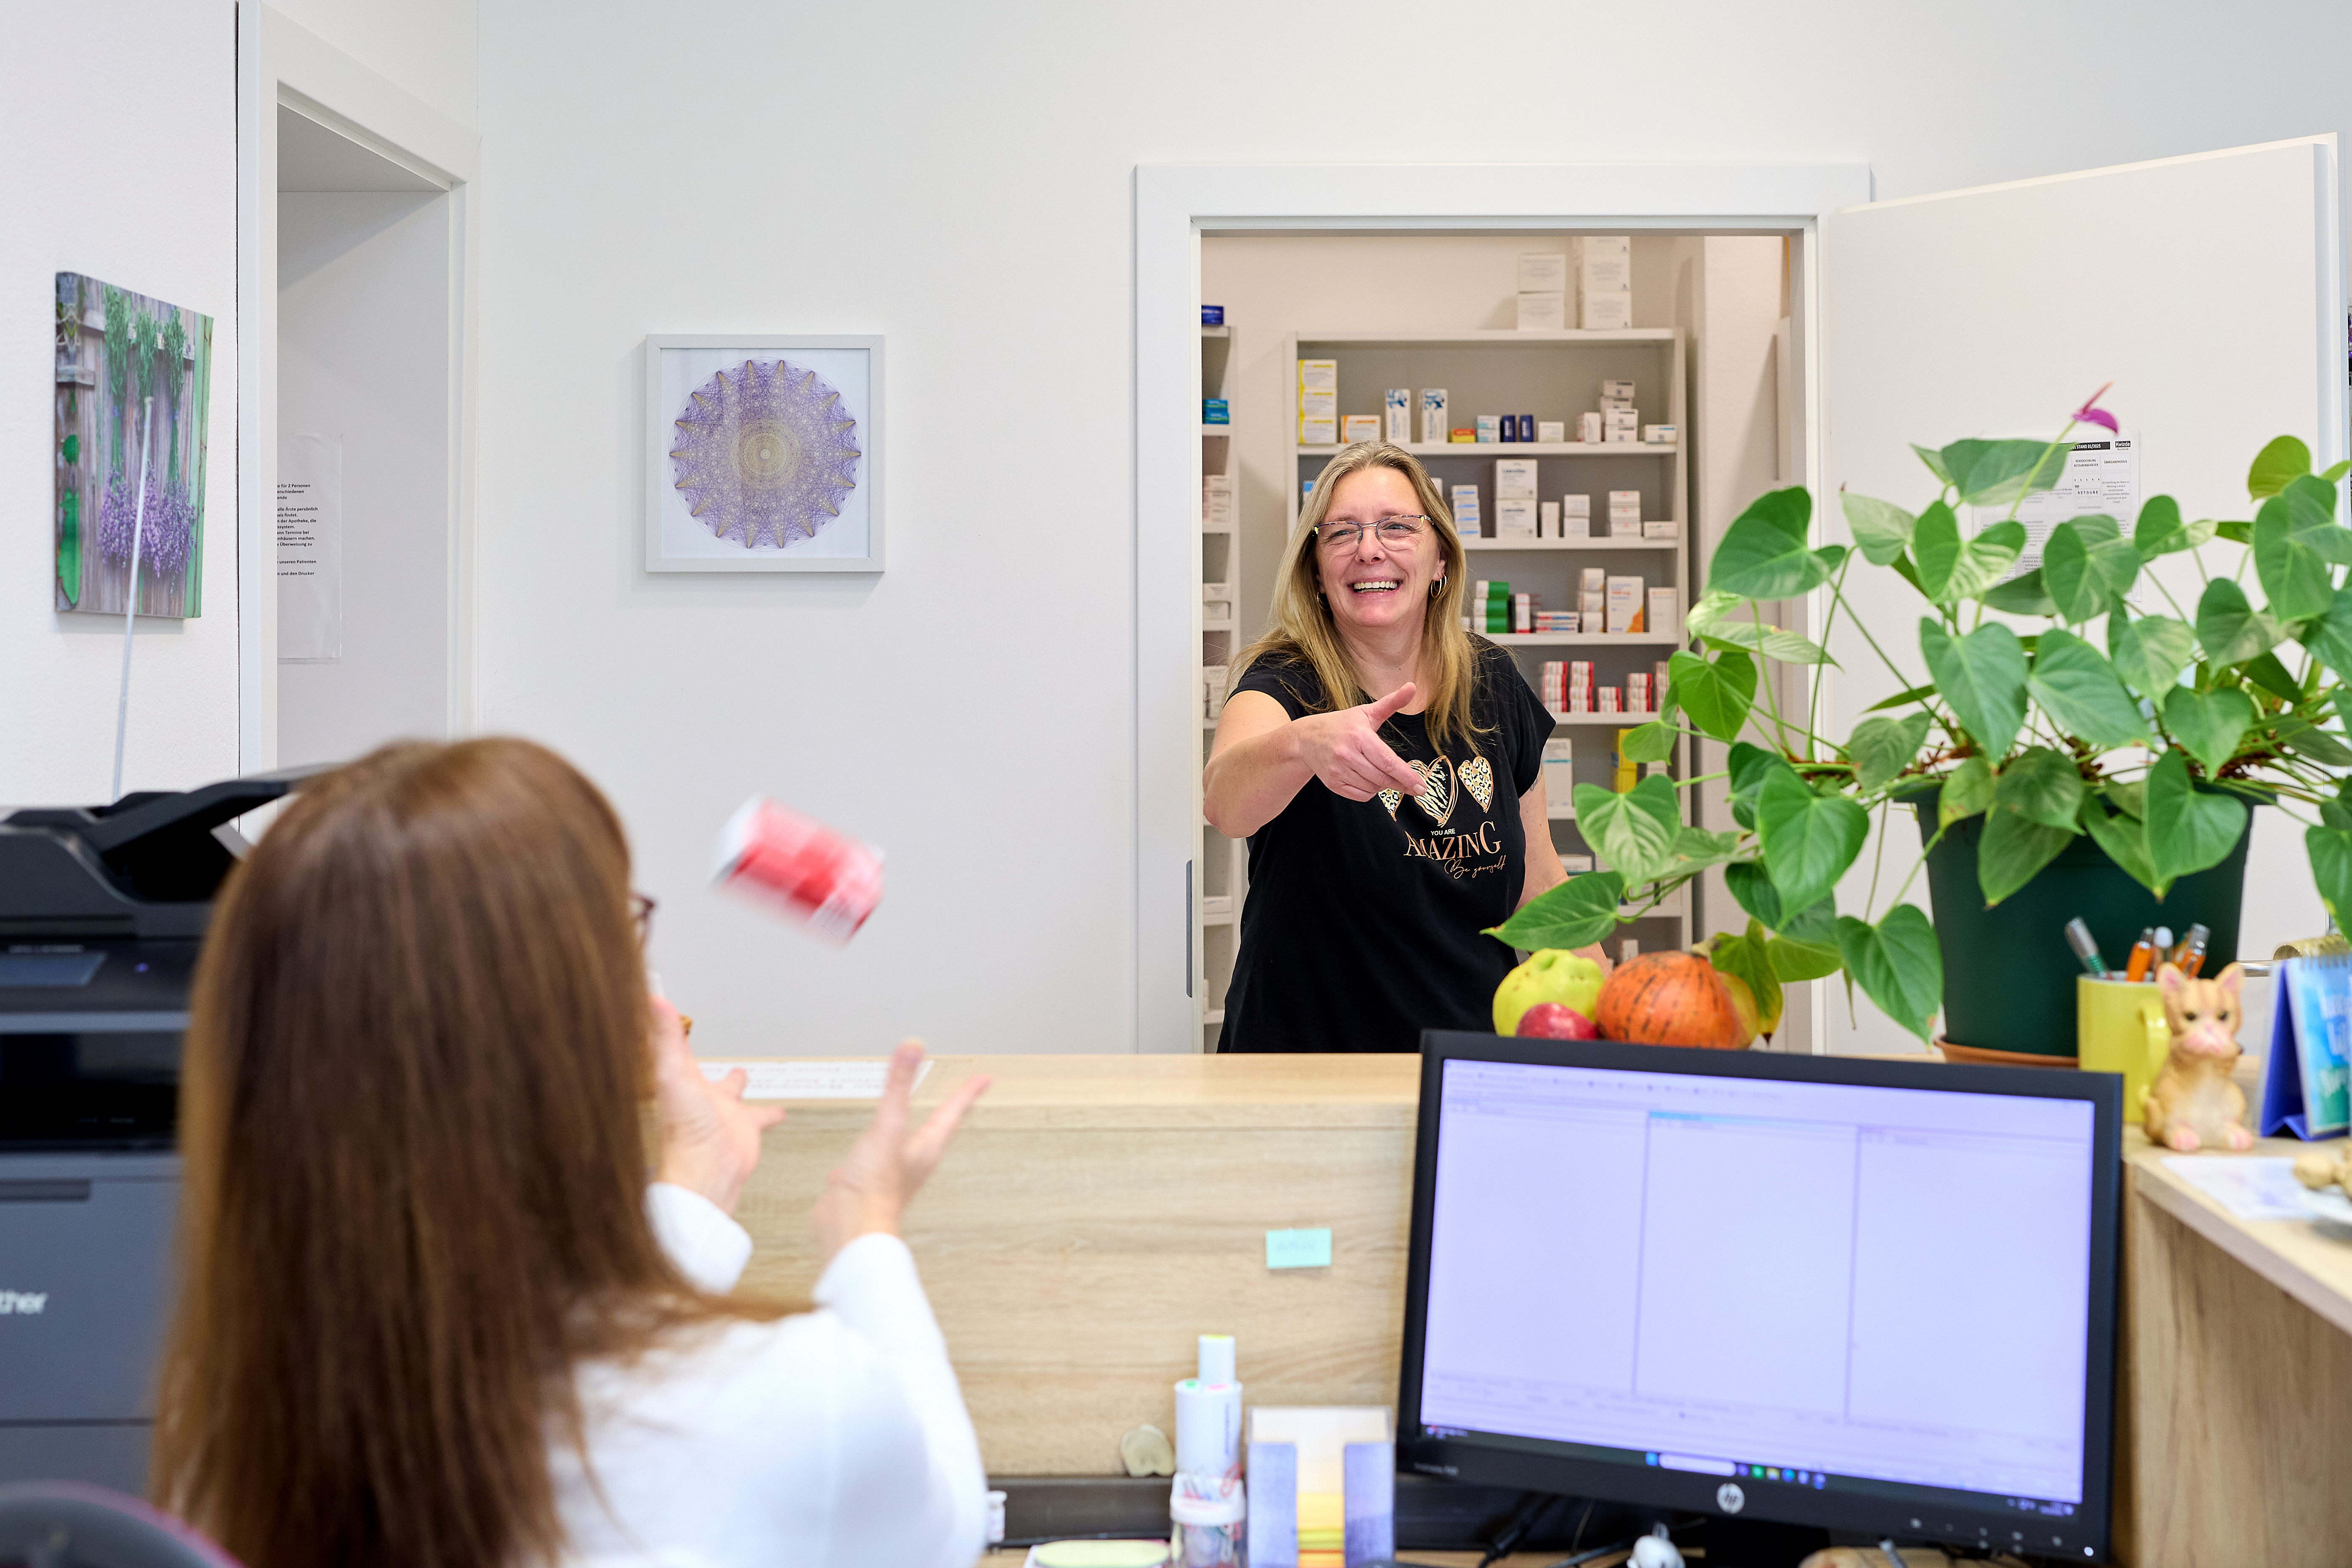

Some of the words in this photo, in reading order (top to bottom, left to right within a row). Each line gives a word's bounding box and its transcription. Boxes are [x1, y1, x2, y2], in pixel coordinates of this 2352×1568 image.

[1403, 821, 1501, 861] AMAZING
[1444, 858, 1470, 879] Be
[1472, 855, 1506, 878] yourself
